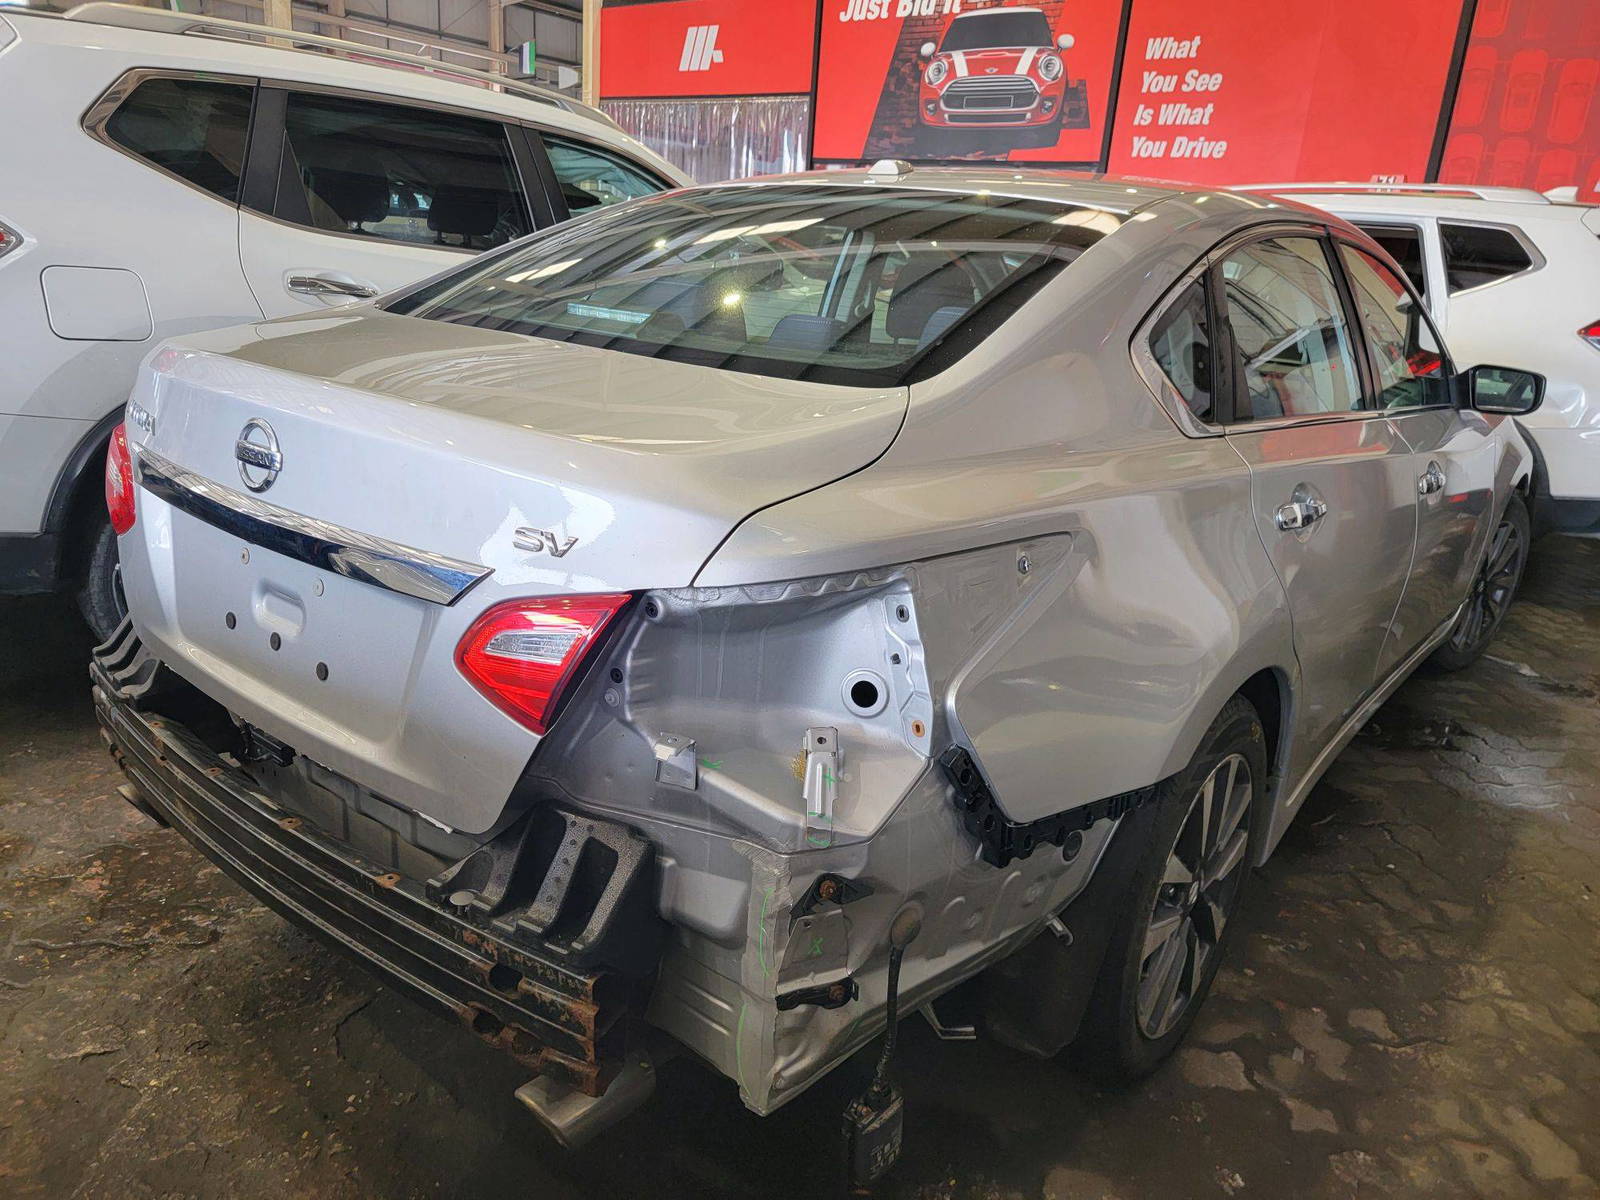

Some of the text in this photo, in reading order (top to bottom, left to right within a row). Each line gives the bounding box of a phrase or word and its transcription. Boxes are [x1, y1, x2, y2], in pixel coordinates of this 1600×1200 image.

[839, 0, 890, 22] Just
[1145, 35, 1201, 60] What
[1141, 69, 1223, 93] You See
[1133, 103, 1214, 126] Is What
[1131, 136, 1227, 158] You Drive
[512, 526, 579, 558] SV
